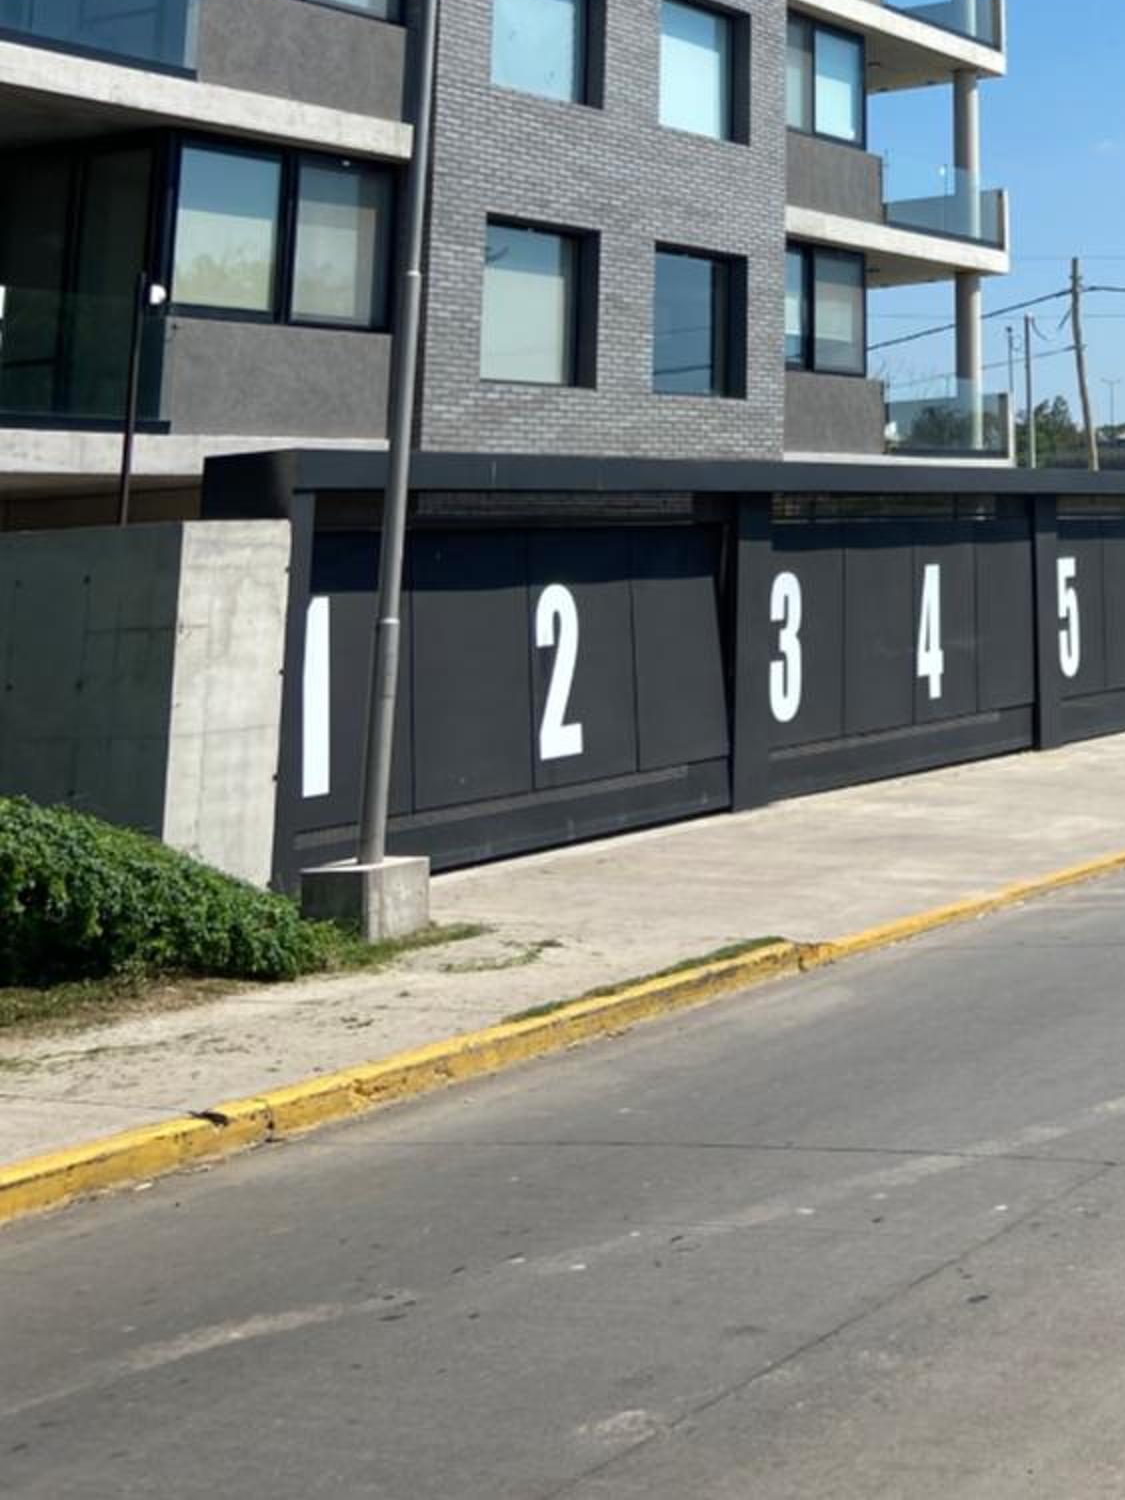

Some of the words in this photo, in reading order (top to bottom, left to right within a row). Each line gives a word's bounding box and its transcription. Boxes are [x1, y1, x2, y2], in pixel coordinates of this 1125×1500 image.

[535, 583, 584, 761] 2
[769, 571, 802, 723] 3
[916, 563, 945, 700] 4
[1056, 556, 1081, 678] 5
[302, 596, 330, 798] 1
